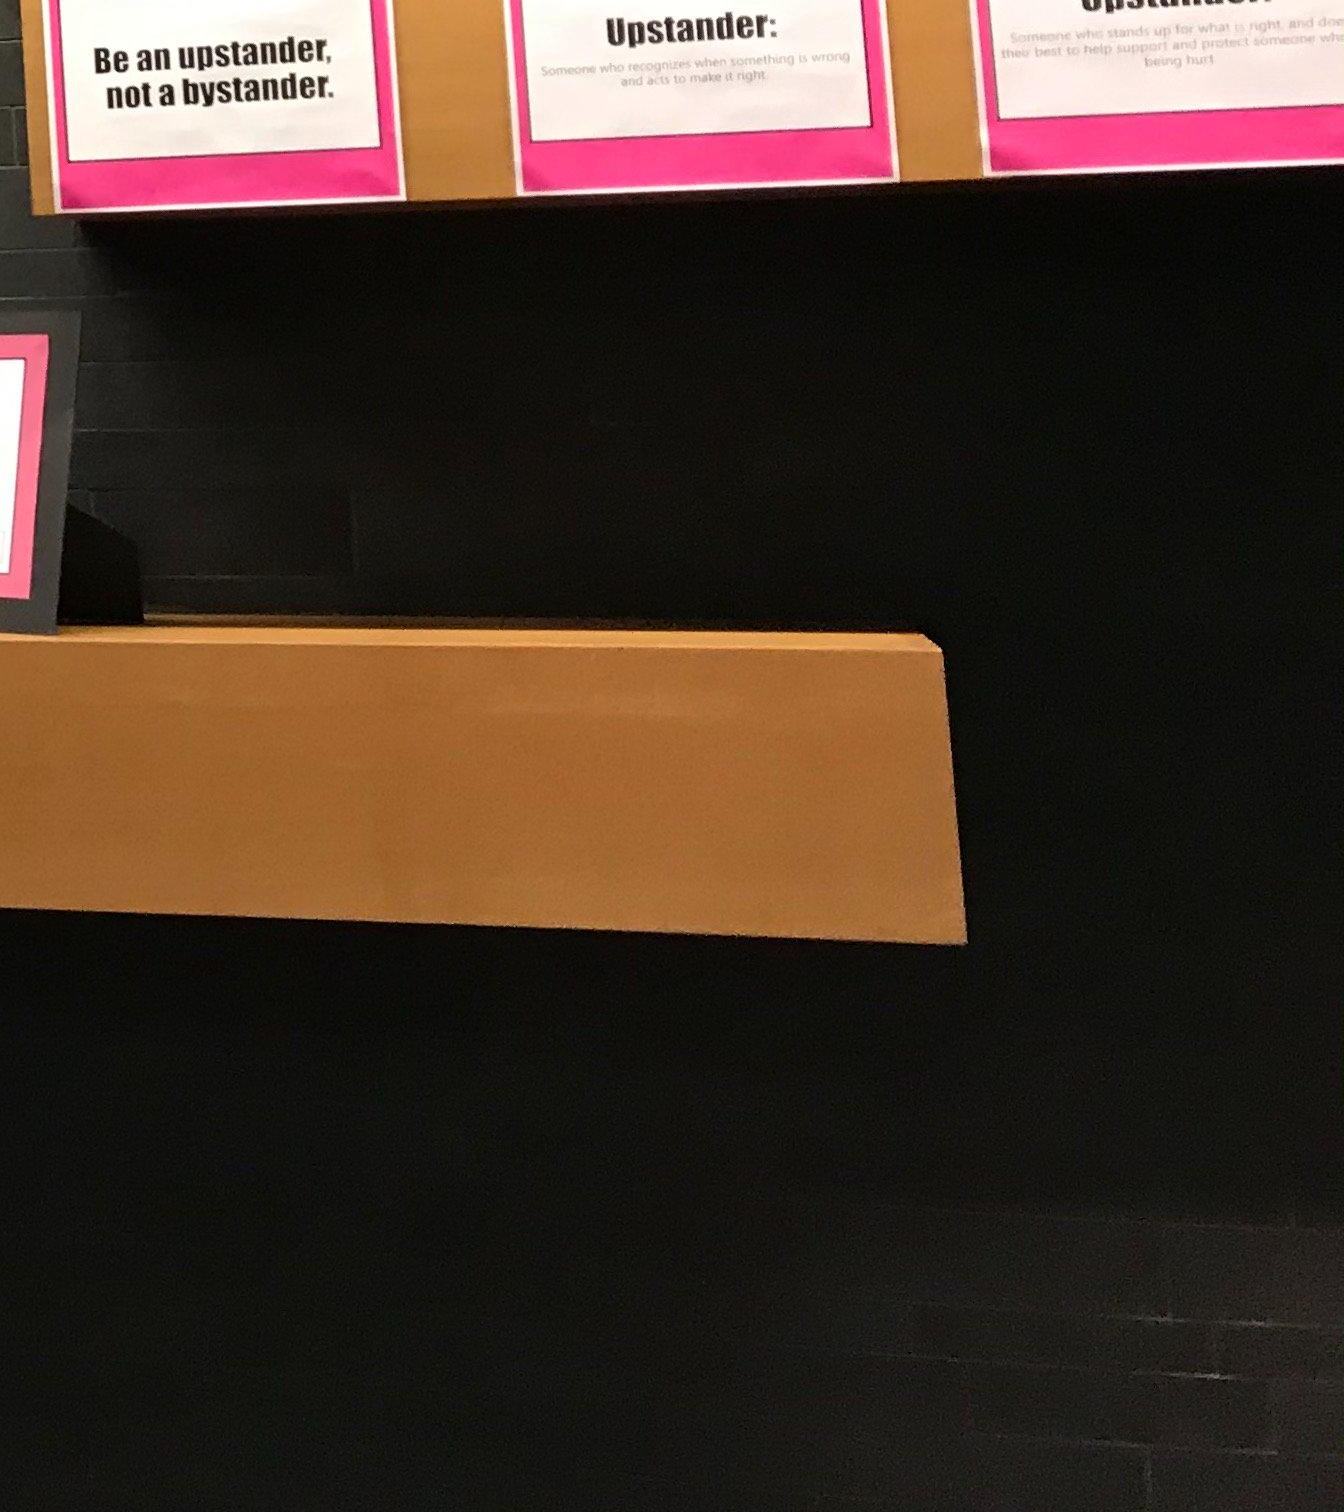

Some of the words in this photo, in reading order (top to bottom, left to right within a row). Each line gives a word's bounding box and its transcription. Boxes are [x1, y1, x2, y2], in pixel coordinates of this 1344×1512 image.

[606, 11, 777, 48] Upstander:
[1010, 31, 1071, 44] Someone
[1075, 28, 1104, 40] who
[1107, 25, 1150, 39] stands
[1154, 25, 1171, 38] up
[1175, 23, 1194, 35] for
[1198, 21, 1231, 34] what
[1288, 16, 1313, 29] and
[93, 46, 129, 74] Be
[137, 45, 171, 71] an
[178, 36, 332, 71] upstander,
[1034, 45, 1062, 58] best
[1066, 44, 1081, 55] to
[1083, 42, 1112, 57] help
[1116, 40, 1169, 55] support
[1172, 38, 1198, 50] and
[1201, 36, 1249, 51] protect
[1253, 34, 1315, 47] someone
[541, 63, 597, 78] Someone
[599, 60, 625, 74] who
[627, 56, 691, 75] recognizes
[694, 55, 727, 69] when
[730, 51, 794, 70] something
[798, 52, 808, 64] is
[811, 49, 850, 65] wrong
[106, 83, 152, 110] not
[159, 81, 176, 106] a
[183, 72, 334, 107] bystander.
[620, 73, 643, 87] and
[646, 72, 670, 86] acts
[673, 72, 687, 85] to
[689, 70, 722, 84] make
[725, 70, 734, 82] it
